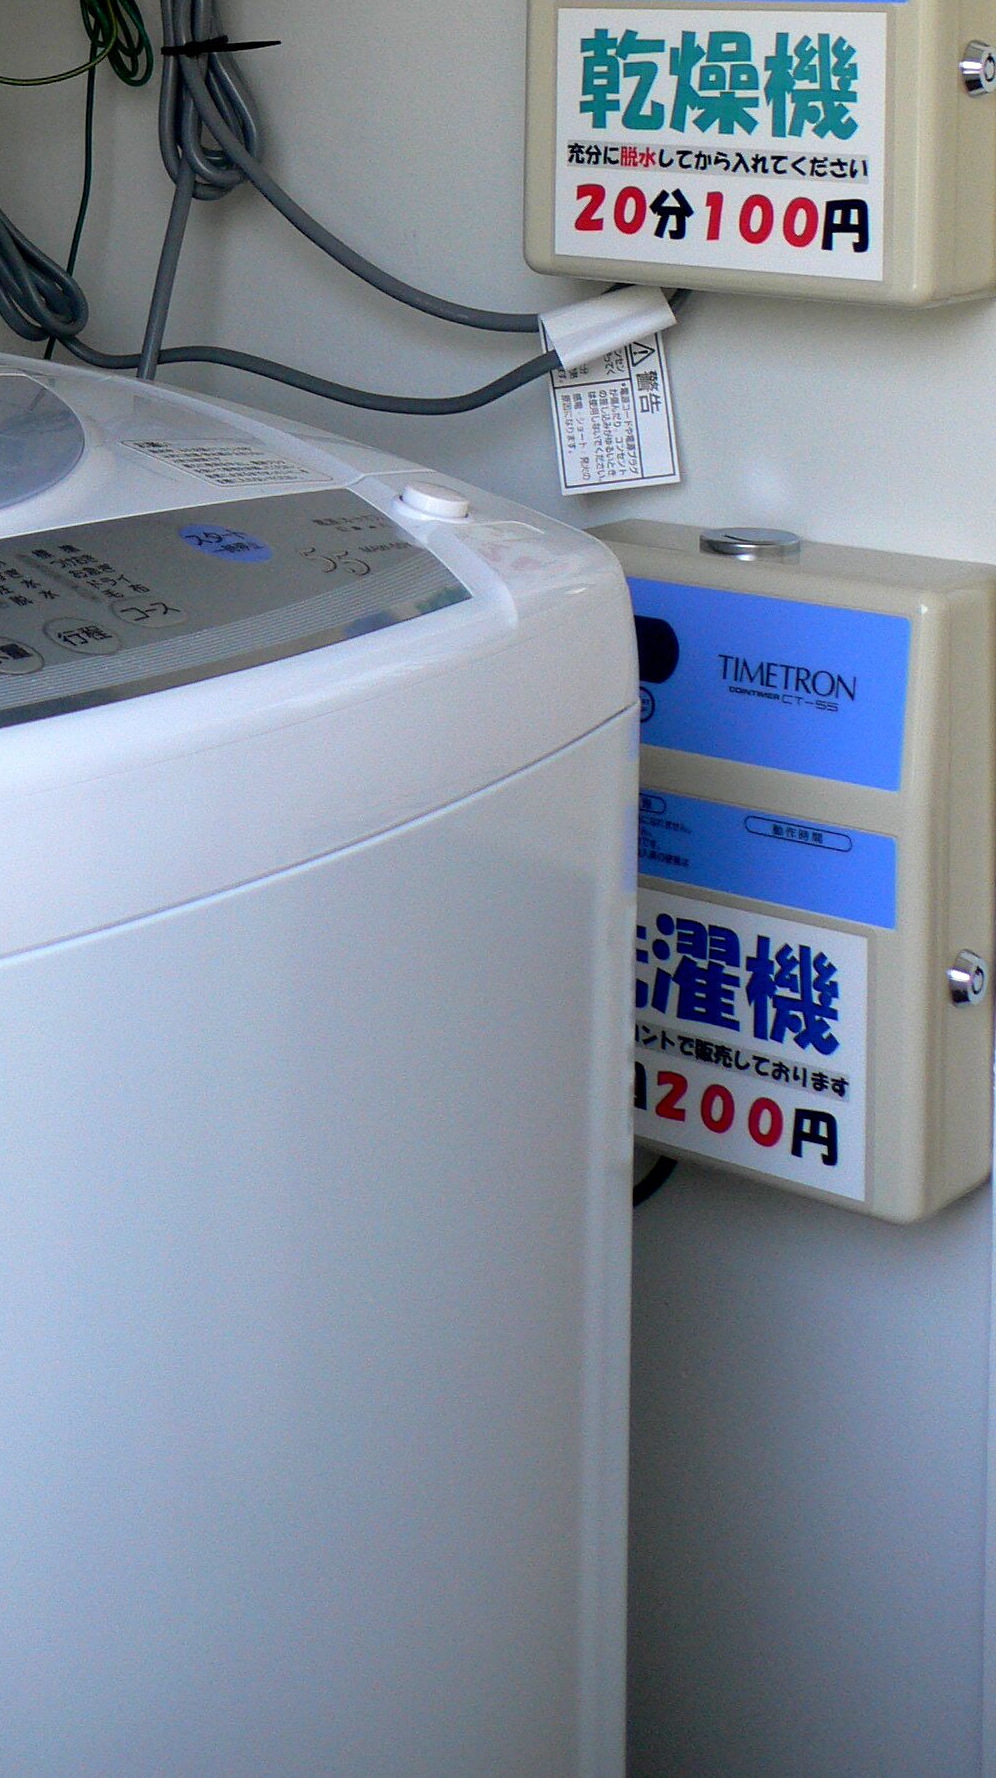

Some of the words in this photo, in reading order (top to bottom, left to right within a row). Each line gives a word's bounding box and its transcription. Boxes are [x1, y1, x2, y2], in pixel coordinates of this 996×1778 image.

[579, 28, 859, 140] 乾燥機
[567, 142, 869, 179] 充分に脱水してから入れてください
[574, 183, 870, 253] 20分100円
[637, 369, 662, 414] 警告
[185, 529, 248, 546] スタート
[86, 573, 132, 589] ドライ
[120, 601, 181, 622] コース
[58, 625, 114, 646] 行程
[718, 654, 857, 701] TIMETRON
[728, 685, 781, 700] COINTIMER
[771, 823, 824, 844] 動作時間
